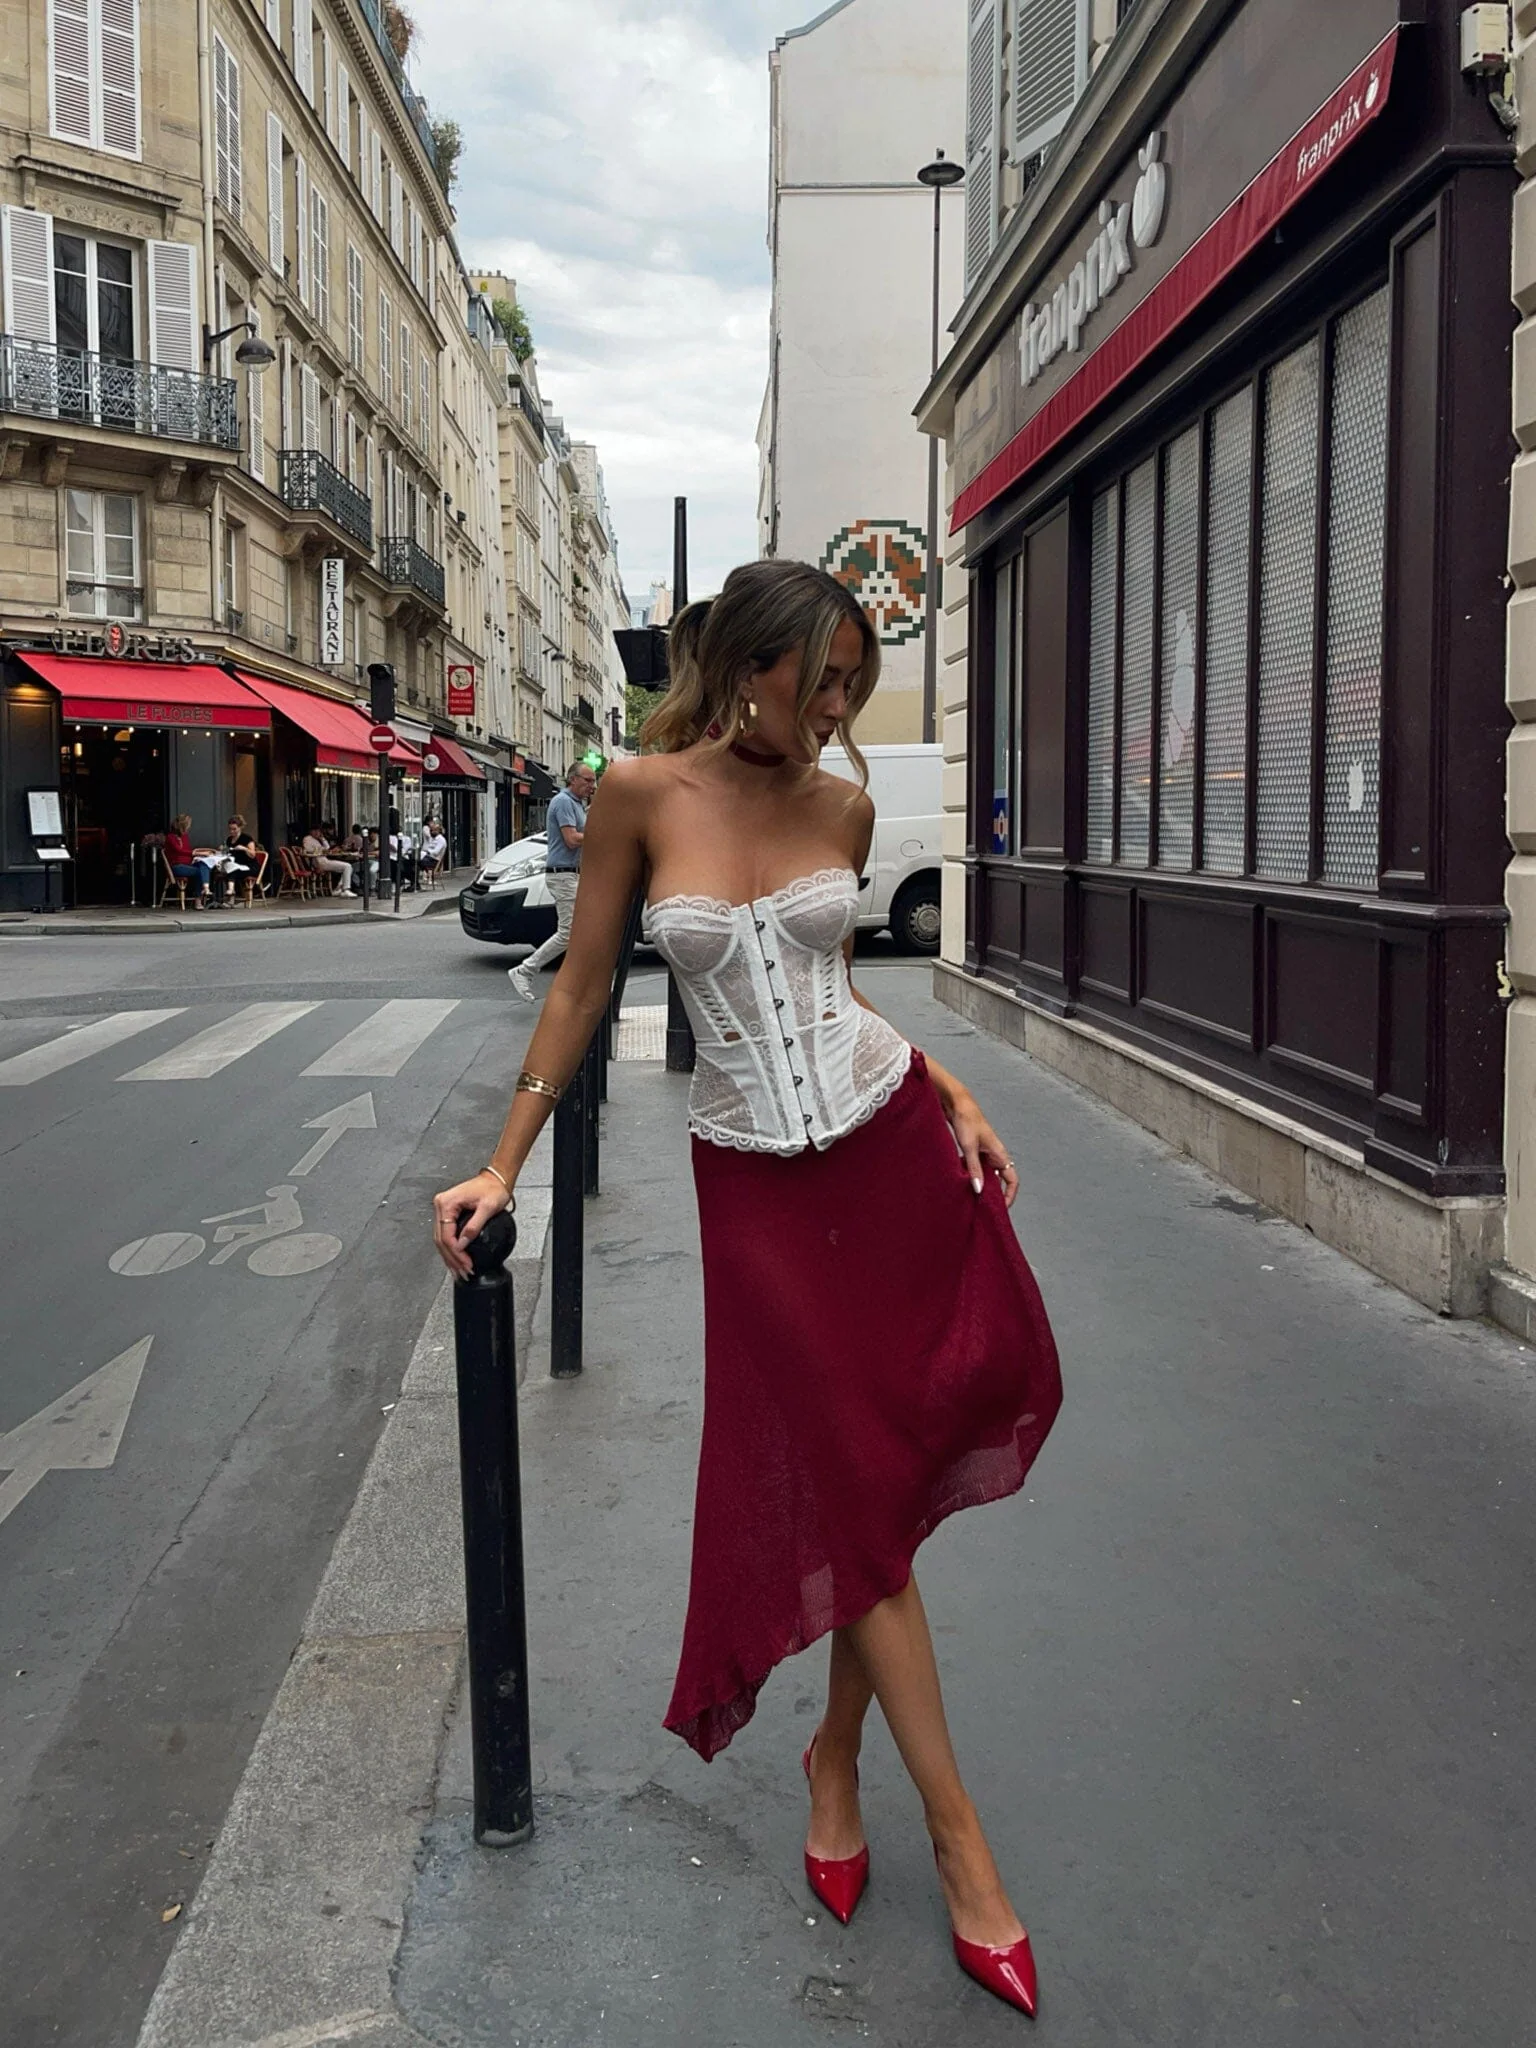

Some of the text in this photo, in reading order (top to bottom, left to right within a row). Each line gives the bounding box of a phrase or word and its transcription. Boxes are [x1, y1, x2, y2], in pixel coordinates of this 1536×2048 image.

[1297, 95, 1361, 182] franprix
[1019, 200, 1131, 387] franprix
[326, 560, 338, 662] RESTAURANT
[127, 703, 147, 719] LE
